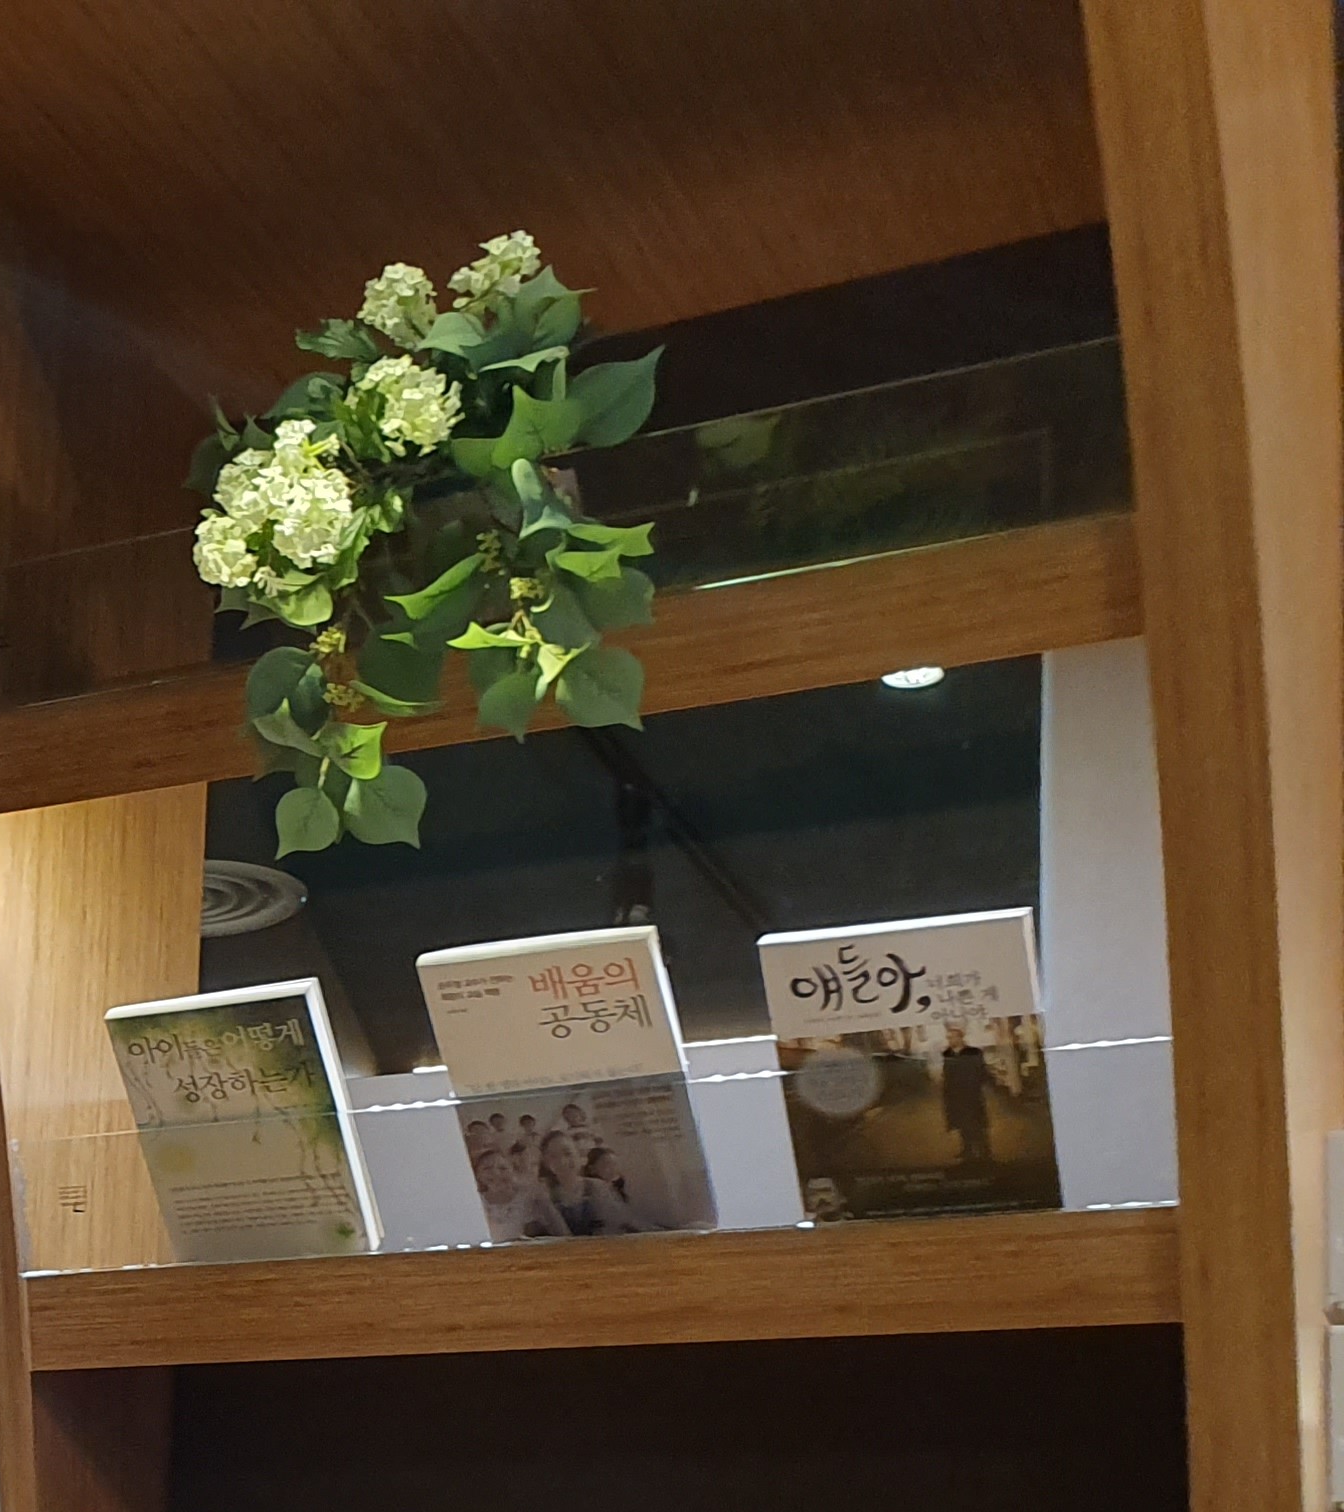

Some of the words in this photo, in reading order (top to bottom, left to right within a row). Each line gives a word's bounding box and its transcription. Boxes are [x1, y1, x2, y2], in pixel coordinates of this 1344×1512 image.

[528, 957, 640, 1000] 배움의
[539, 995, 653, 1039] 공동체
[128, 1033, 222, 1065] 아이들은
[222, 1018, 305, 1051] 어떻게
[174, 1060, 315, 1104] 성장하는가
